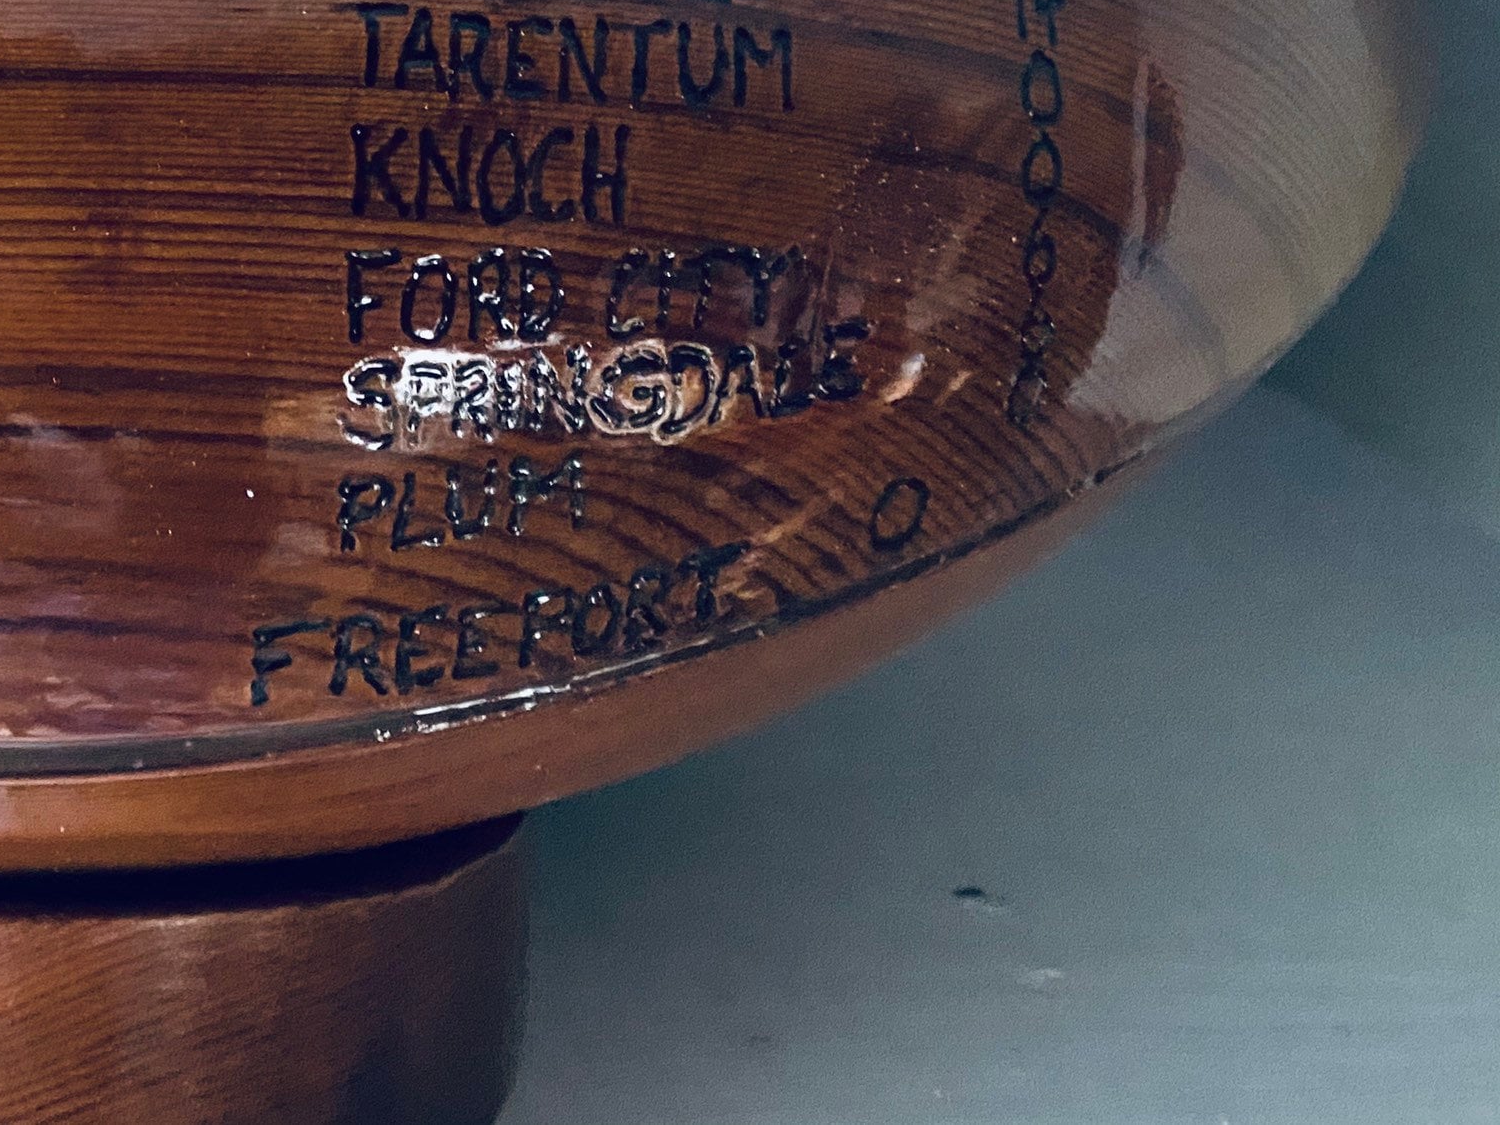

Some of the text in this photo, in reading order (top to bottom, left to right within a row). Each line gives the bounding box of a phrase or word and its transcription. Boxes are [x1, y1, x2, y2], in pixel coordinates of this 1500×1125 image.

[332, 2, 797, 112] TARENTUM
[348, 123, 633, 225] KNOCH
[344, 247, 566, 344] FORD
[337, 448, 588, 555] PLUM
[249, 540, 752, 706] FREEPORT
